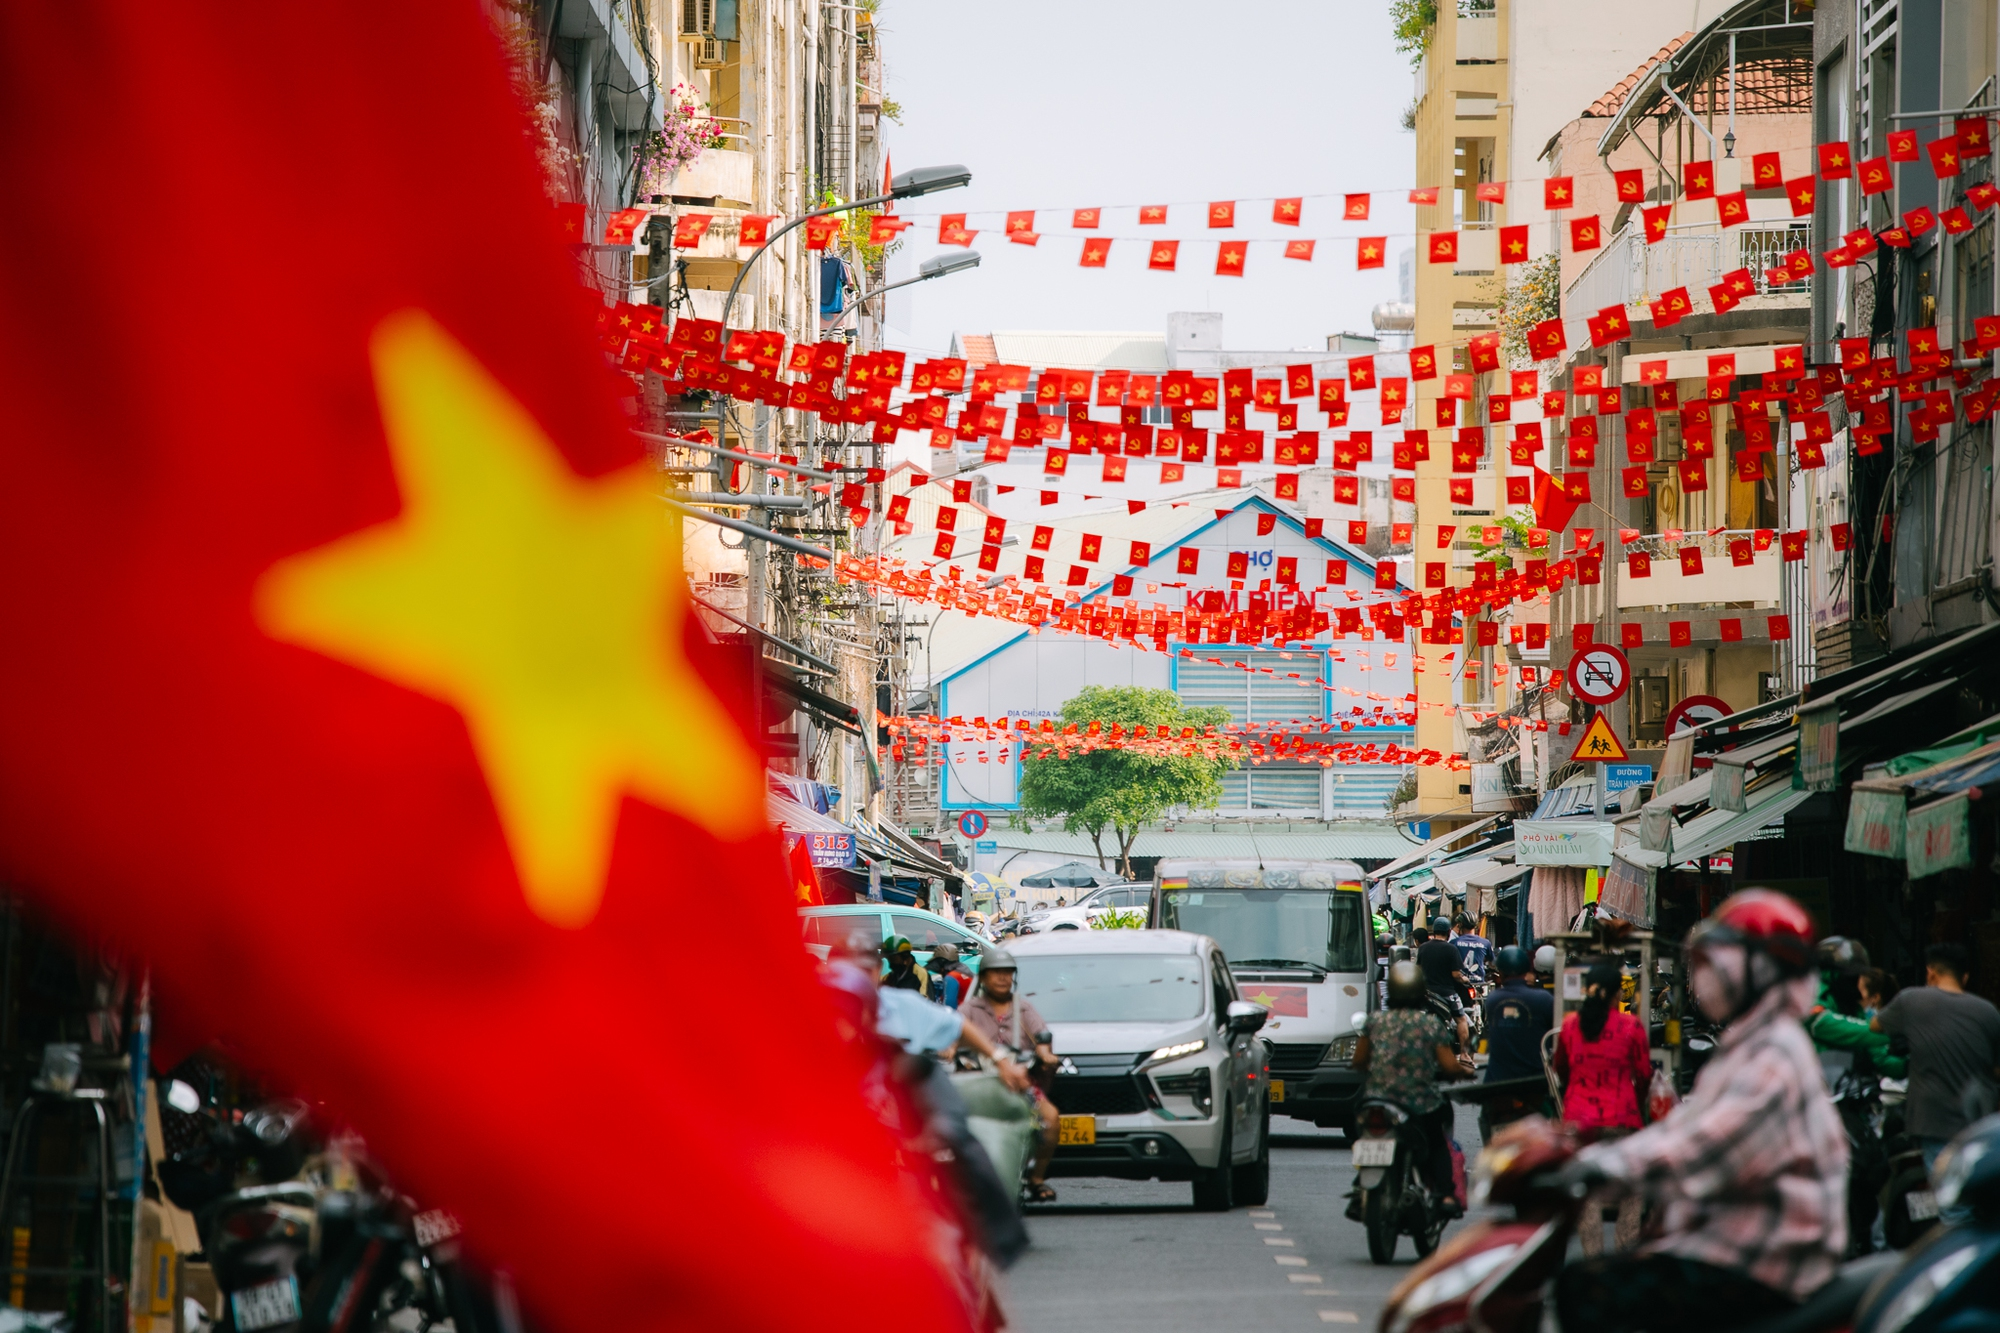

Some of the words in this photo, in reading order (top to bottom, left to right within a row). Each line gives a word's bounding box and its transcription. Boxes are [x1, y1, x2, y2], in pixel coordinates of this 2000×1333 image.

[1232, 549, 1273, 571] HỢ
[1186, 590, 1239, 613] KM
[1616, 768, 1643, 776] ĐƯỜNG
[813, 835, 849, 850] 515
[1463, 950, 1475, 970] 4
[1060, 1118, 1078, 1130] 0E
